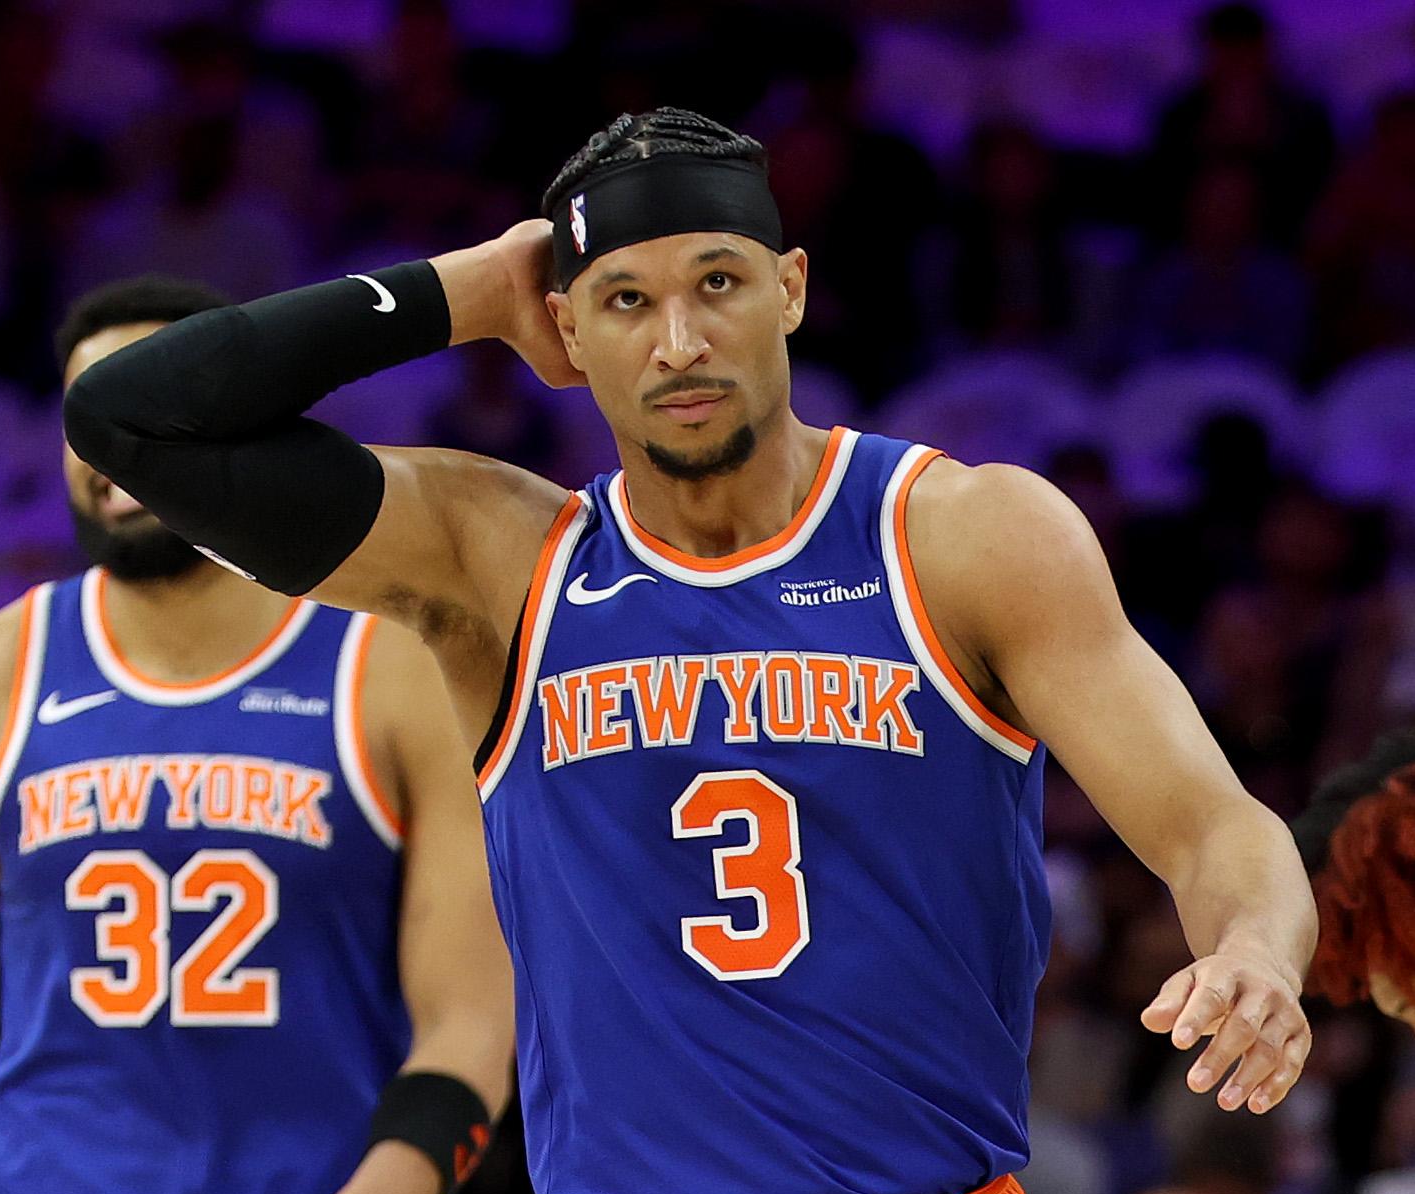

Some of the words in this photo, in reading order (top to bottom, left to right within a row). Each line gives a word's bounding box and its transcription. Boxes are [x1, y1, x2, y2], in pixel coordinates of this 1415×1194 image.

[780, 579, 836, 590] experience
[780, 591, 820, 606] abu
[822, 576, 882, 604] dhabi
[537, 655, 711, 772] NEW
[711, 651, 925, 757] YORK
[17, 755, 155, 855] NEW
[157, 753, 333, 850] YORK
[671, 769, 811, 981] 3
[64, 848, 280, 1029] 32
